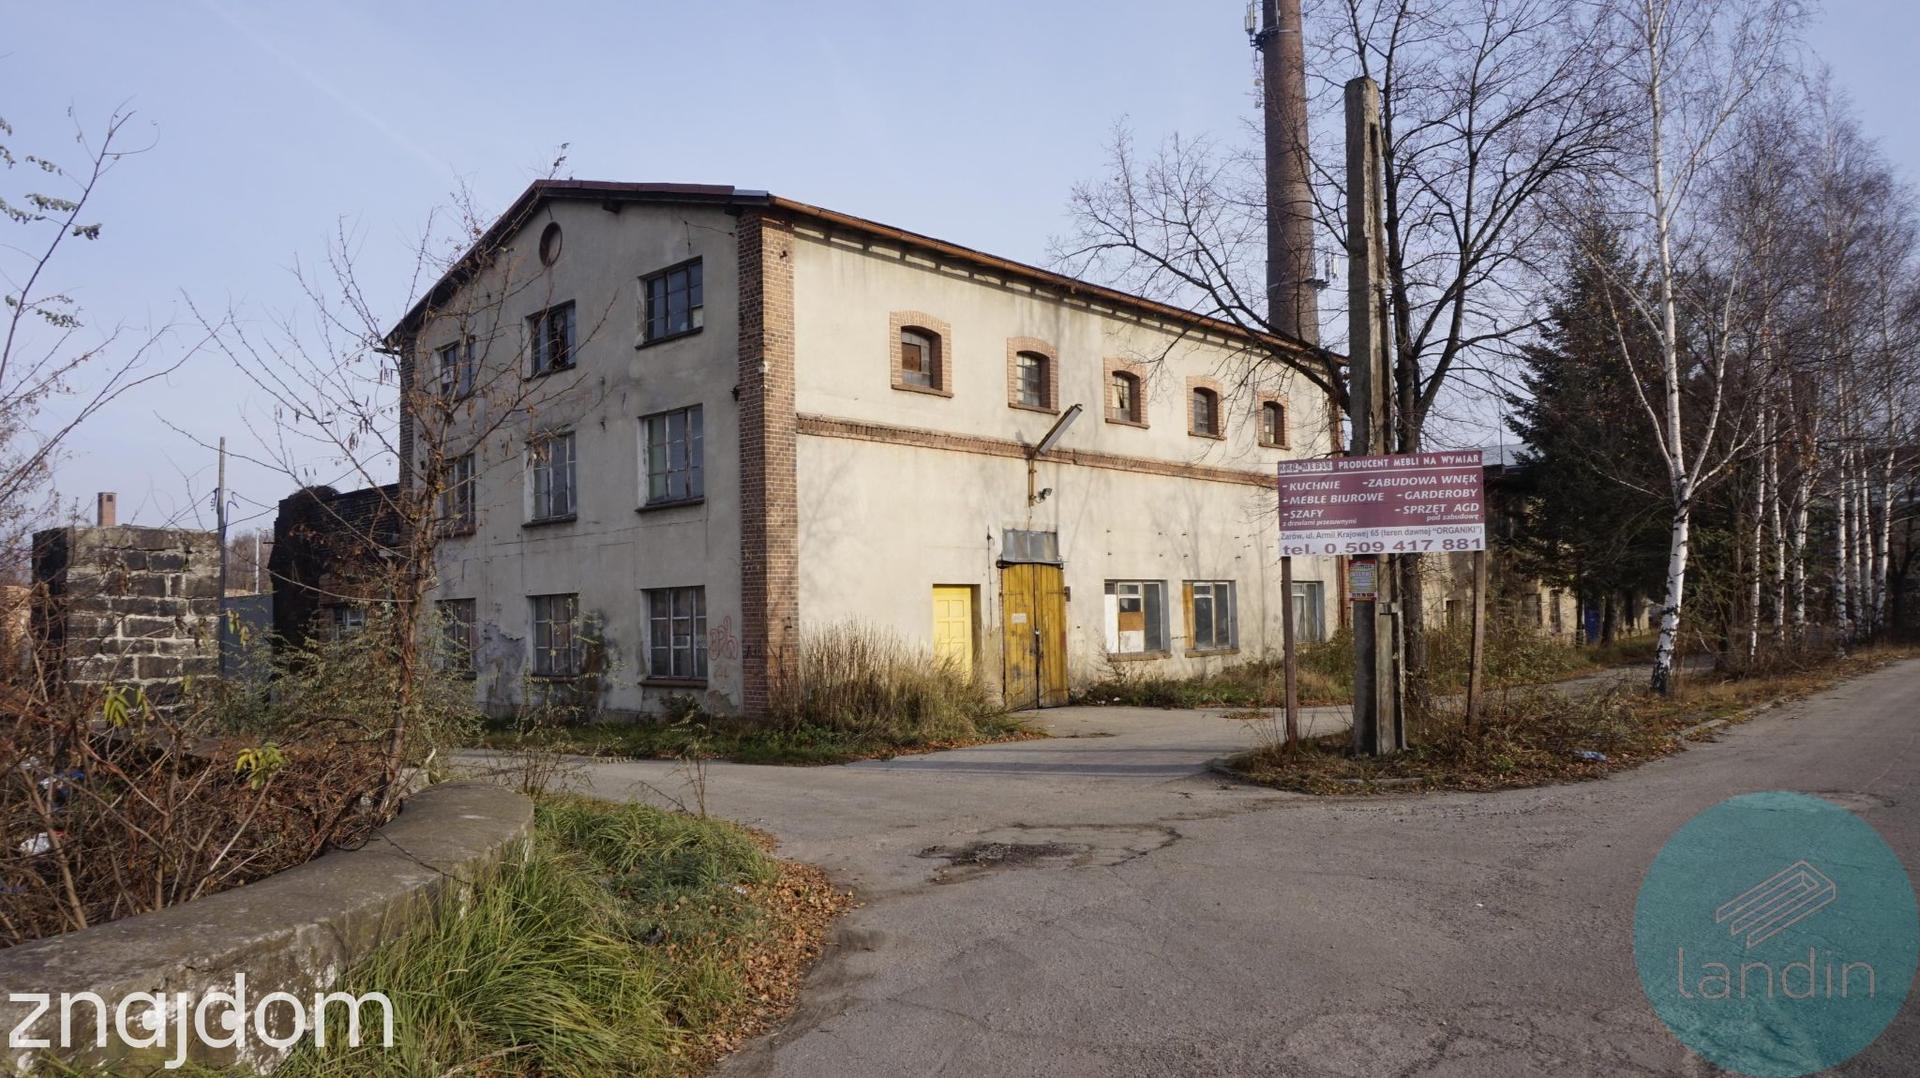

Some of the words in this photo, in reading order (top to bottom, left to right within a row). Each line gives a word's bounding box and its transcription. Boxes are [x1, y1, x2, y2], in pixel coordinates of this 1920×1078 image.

[1338, 458, 1389, 469] PRODUCENT
[1393, 457, 1419, 467] MEBLI
[1423, 456, 1437, 465] NA
[1441, 454, 1479, 464] WYMIAR
[1441, 474, 1478, 485] WNĘK
[1330, 492, 1385, 503] BIUROWE
[1454, 502, 1480, 512] AGD
[1426, 514, 1441, 522] pod
[1316, 531, 1336, 539] Armii
[1337, 529, 1369, 539] Krajowej
[1404, 527, 1431, 537] dawnej
[1283, 543, 1316, 555] tel.
[1345, 541, 1385, 553] 509
[1392, 539, 1434, 551] 417
[1442, 538, 1481, 550] 881
